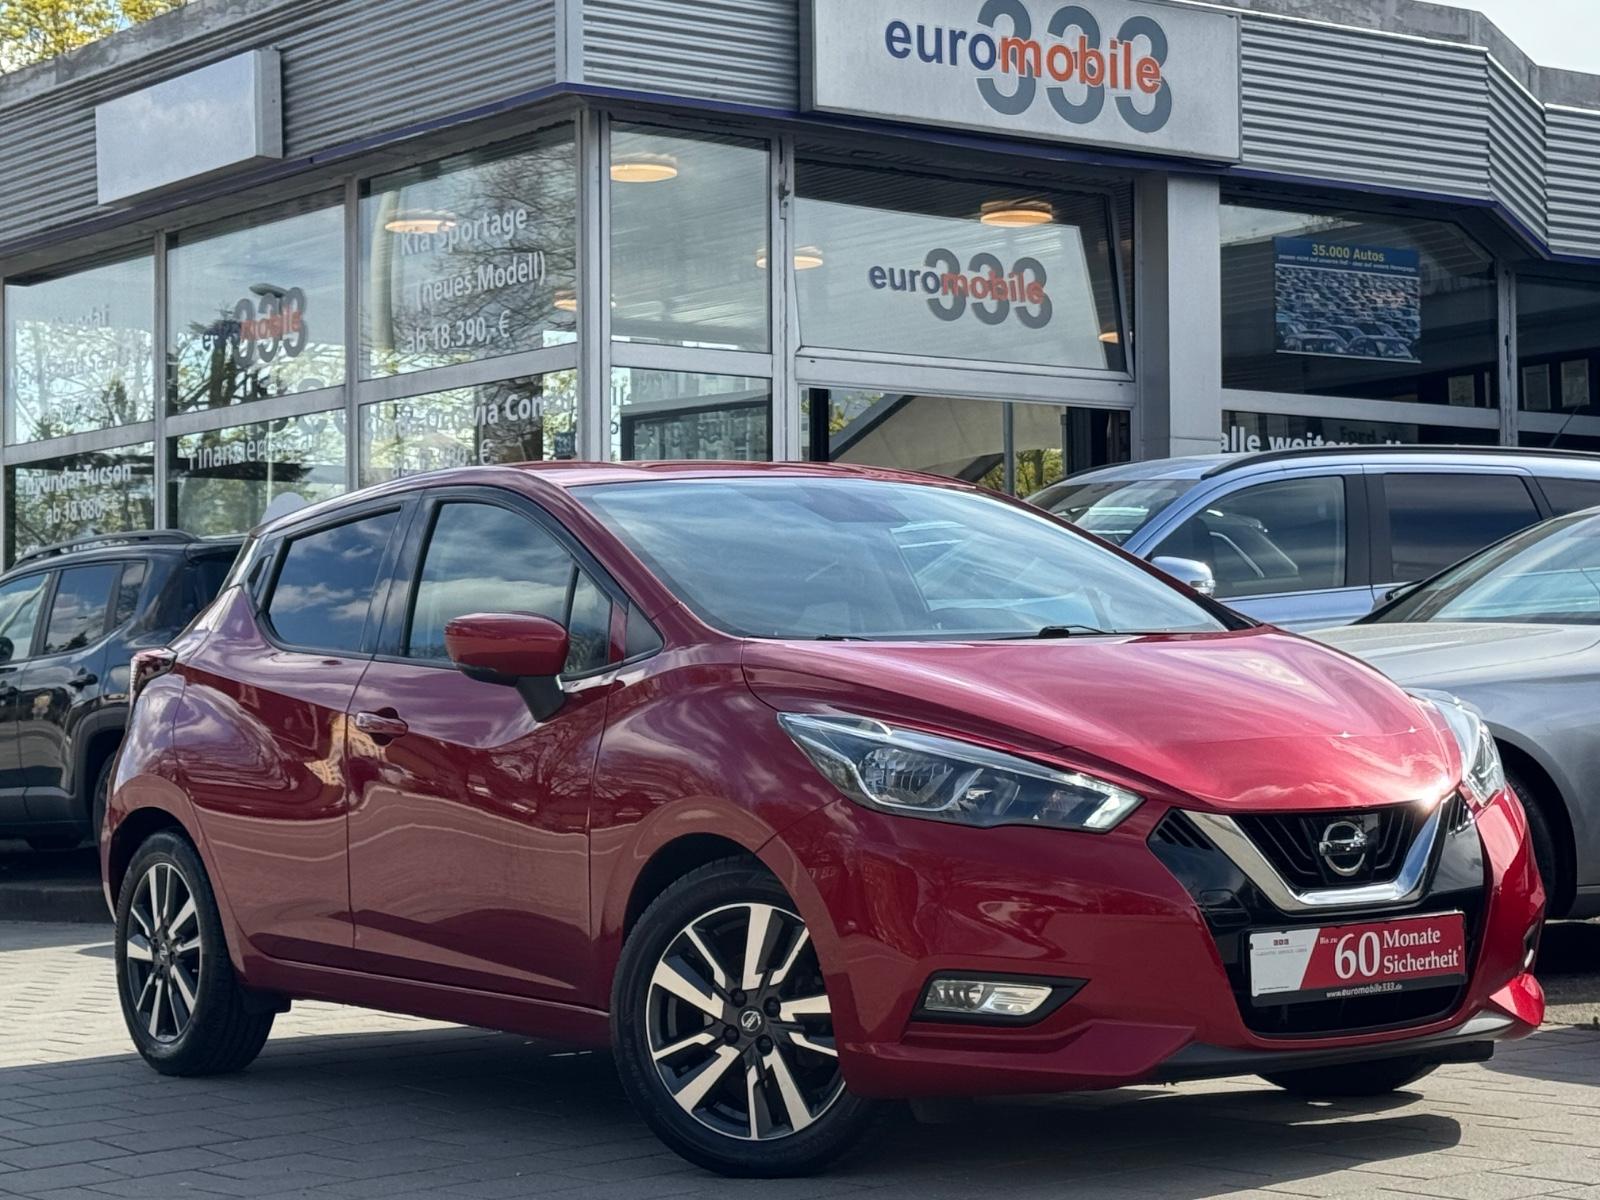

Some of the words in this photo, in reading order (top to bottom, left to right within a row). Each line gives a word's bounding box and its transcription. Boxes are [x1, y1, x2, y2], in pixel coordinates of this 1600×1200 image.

[885, 17, 1162, 93] euromobile
[975, 0, 1172, 133] 333
[437, 208, 528, 252] Sportage
[1311, 243, 1350, 259] 35.000
[1353, 248, 1385, 262] Autos
[416, 276, 472, 311] (neues
[477, 250, 546, 291] Modell)
[869, 265, 1044, 304] euromobile
[924, 248, 1052, 329] 333
[406, 326, 426, 352] ab
[499, 308, 511, 339] €
[1217, 425, 1262, 452] alle
[84, 463, 131, 487] Tucson
[1335, 931, 1381, 980] 60
[1383, 927, 1441, 948] Monate
[1326, 982, 1403, 998] www.euromobile333.de
